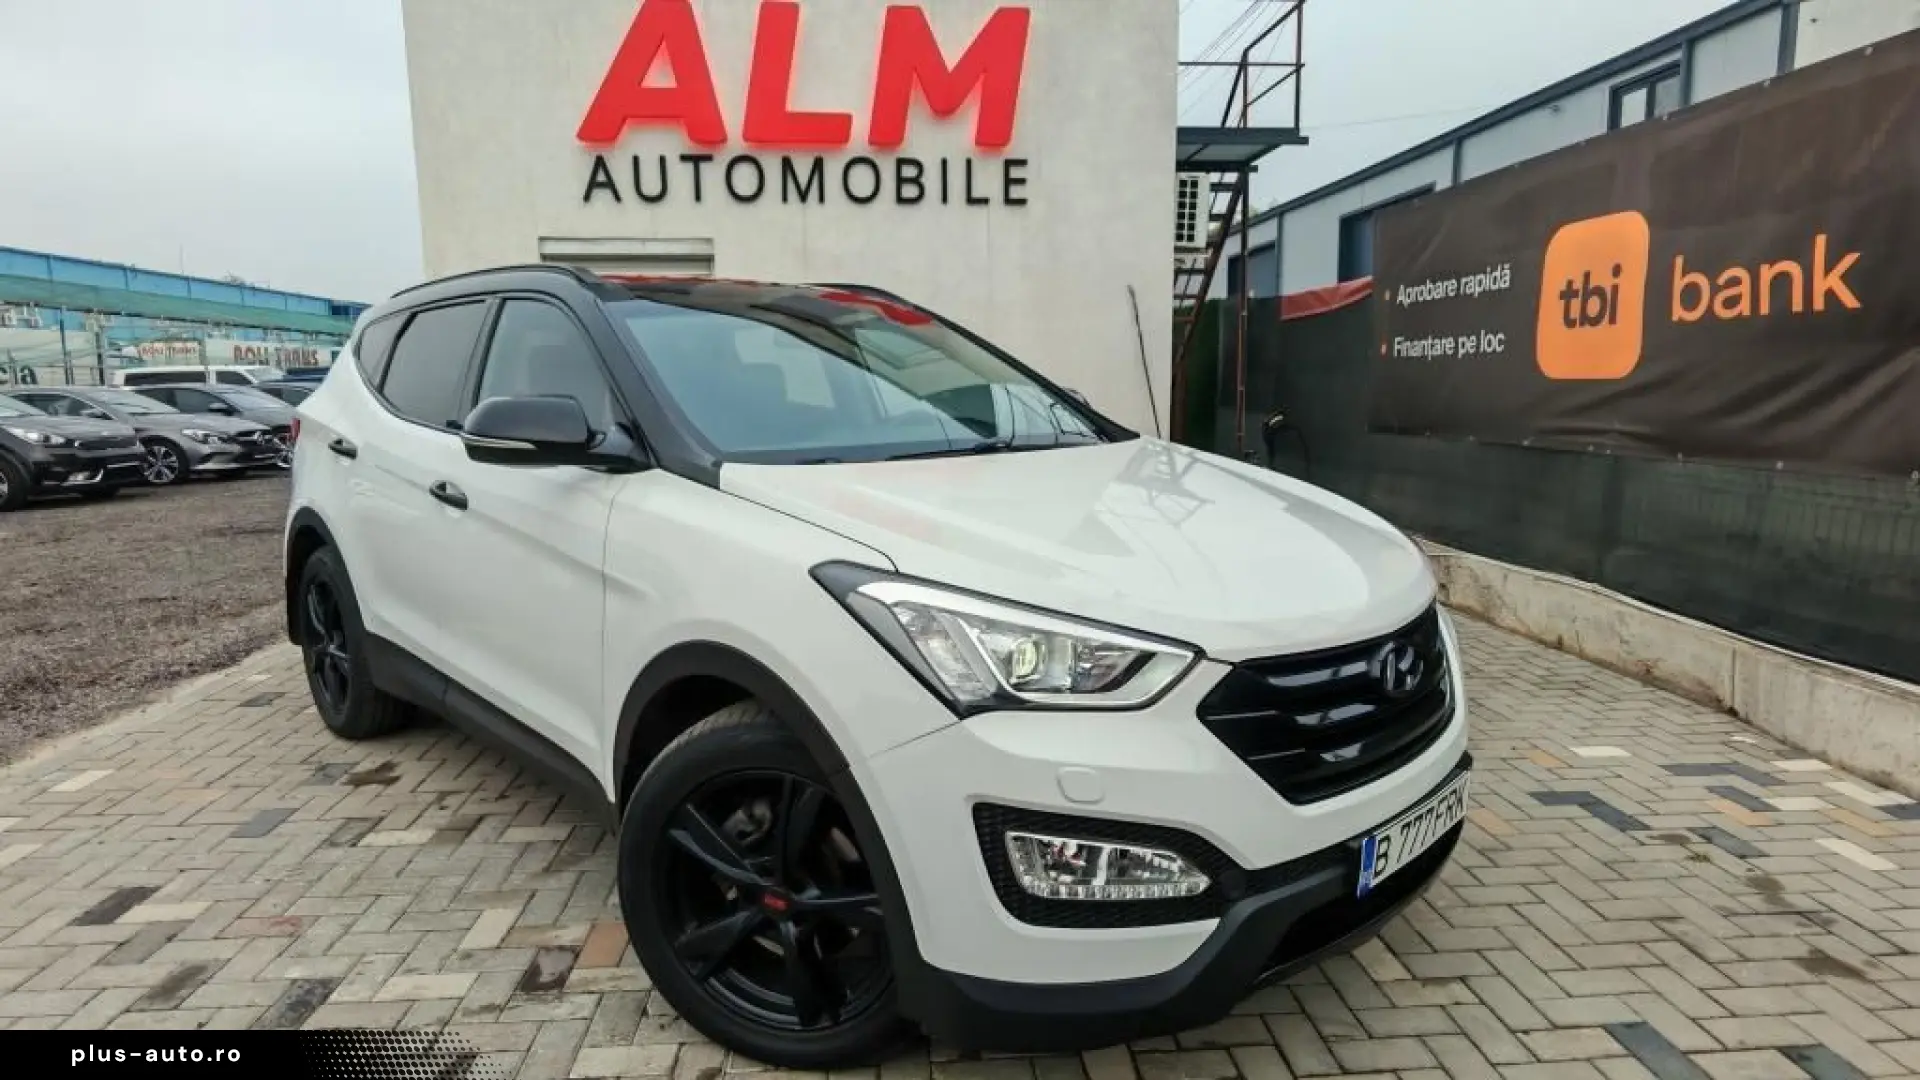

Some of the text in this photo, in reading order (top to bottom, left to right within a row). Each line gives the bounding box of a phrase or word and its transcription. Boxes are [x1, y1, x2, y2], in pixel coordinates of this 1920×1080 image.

[576, 0, 1030, 147] ALM
[583, 154, 1029, 205] AUTOMOBILE
[1396, 262, 1511, 308] Aprobare rapidă
[1558, 233, 1862, 330] tbi bank
[1458, 335, 1477, 358] pe
[1481, 329, 1505, 353] loc
